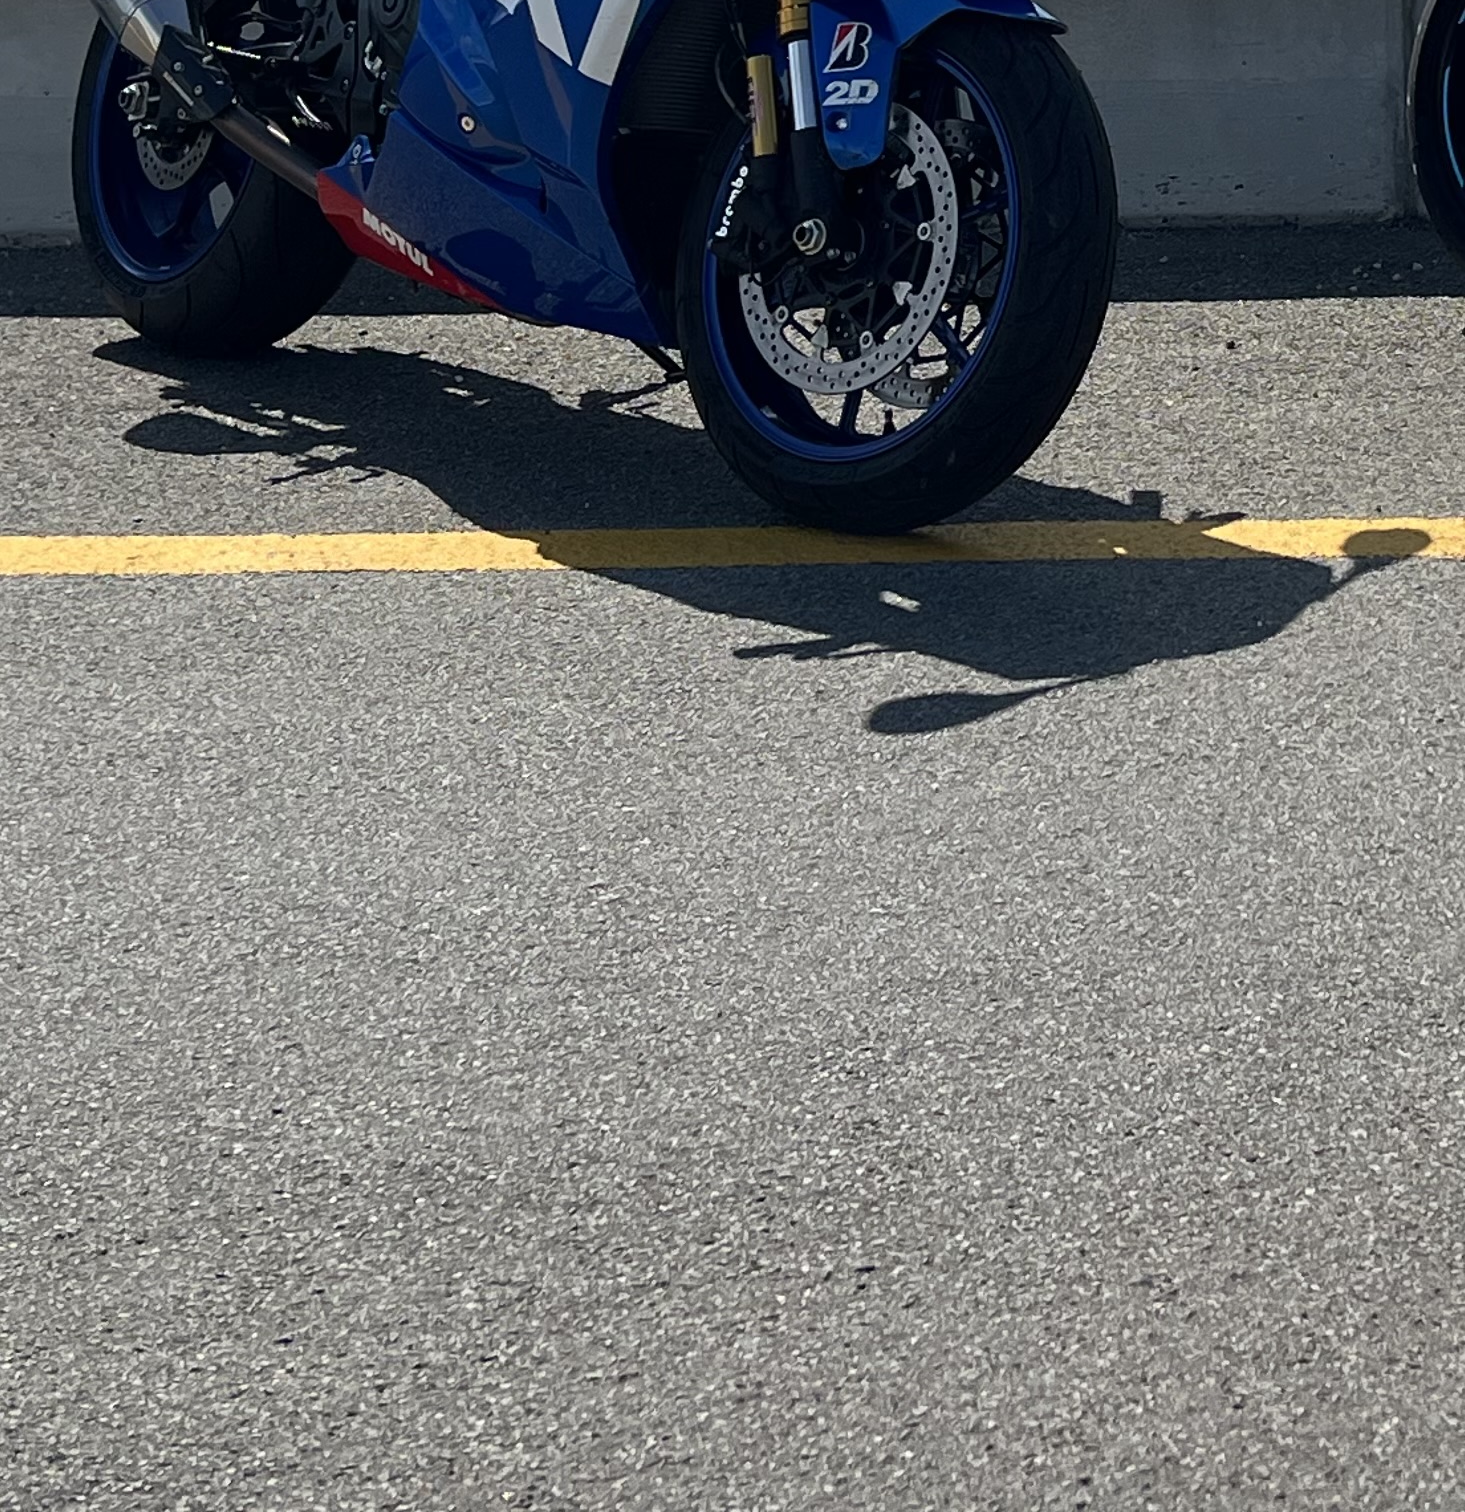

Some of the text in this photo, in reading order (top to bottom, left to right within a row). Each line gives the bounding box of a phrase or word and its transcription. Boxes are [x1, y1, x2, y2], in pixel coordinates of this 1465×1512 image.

[822, 79, 879, 106] 2D
[714, 165, 749, 238] brembo
[362, 207, 434, 276] MOTUL
